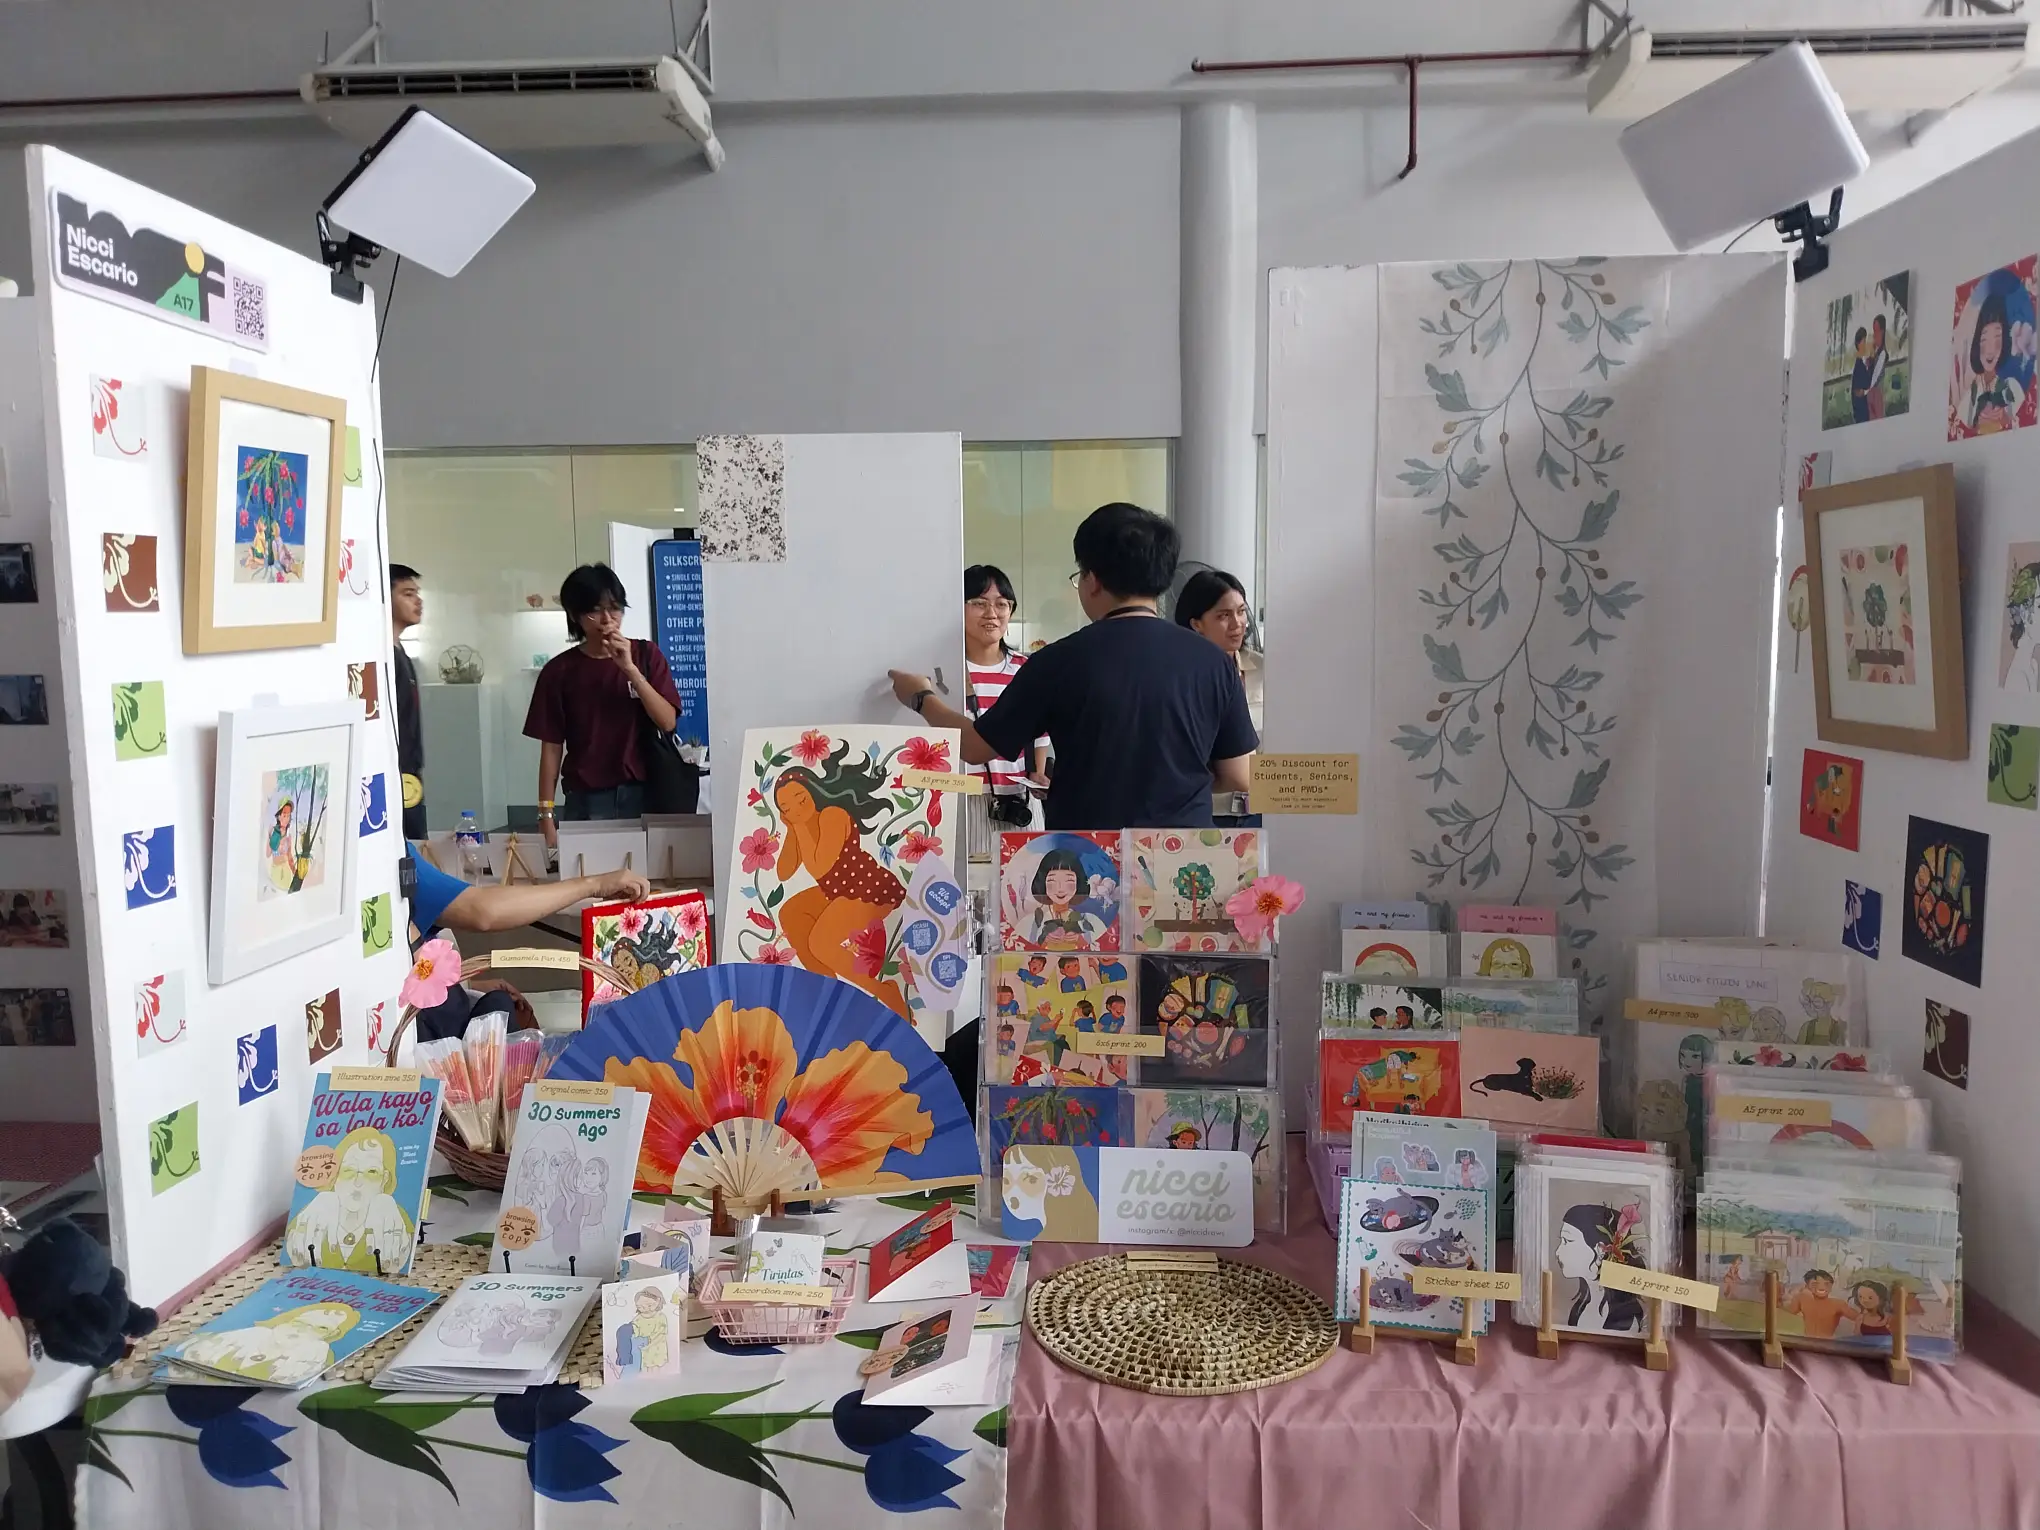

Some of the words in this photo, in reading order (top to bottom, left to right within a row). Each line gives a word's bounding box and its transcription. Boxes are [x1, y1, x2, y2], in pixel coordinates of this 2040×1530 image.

[66, 223, 114, 260] Nicci
[67, 246, 139, 288] Escario
[173, 293, 195, 313] A17
[666, 617, 694, 629] OTHER
[673, 677, 707, 689] MBROID
[680, 709, 693, 717] APS
[1259, 759, 1278, 769] 20%
[1281, 759, 1327, 769] Discount
[1332, 759, 1350, 769] for
[1254, 772, 1303, 782] Students,
[1309, 772, 1353, 783] Seniors,
[1278, 785, 1296, 794] and
[928, 890, 951, 909] accept
[1746, 980, 1769, 989] LANE
[1109, 1040, 1131, 1050] print
[1133, 1041, 1147, 1049] 200
[336, 1072, 383, 1082] Illustration
[401, 1074, 417, 1082] 350
[539, 1085, 571, 1096] Original
[571, 1086, 593, 1095] comic
[594, 1088, 609, 1096] 350
[313, 1091, 376, 1118] Wala
[378, 1090, 436, 1114] kayo
[1742, 1104, 1756, 1114] A5
[1756, 1106, 1783, 1117] print
[1787, 1107, 1805, 1117] 200
[527, 1101, 553, 1122] 30
[554, 1106, 622, 1121] Summers
[314, 1120, 343, 1138] sa
[346, 1111, 390, 1135] lola
[391, 1103, 432, 1129] ko!
[577, 1122, 609, 1143] Ago
[301, 1151, 335, 1162] browsing
[1119, 1158, 1231, 1198] nicci
[1116, 1194, 1237, 1223] escario
[505, 1211, 537, 1225] browsing
[761, 1266, 805, 1281] Tirintas
[468, 1281, 502, 1292] 30
[503, 1283, 585, 1293] Summers
[1424, 1275, 1462, 1287] Sticker
[1464, 1278, 1491, 1289] sheet
[1494, 1281, 1510, 1290] 150
[1628, 1275, 1642, 1287] A6
[1641, 1280, 1671, 1293] print
[1673, 1286, 1690, 1297] 150
[286, 1276, 363, 1297] Wala
[364, 1288, 426, 1306] kayo
[287, 1291, 317, 1301] sa
[530, 1291, 566, 1302] Ago
[732, 1287, 780, 1296] Accordion
[782, 1289, 803, 1297] zine
[806, 1290, 824, 1299] 250
